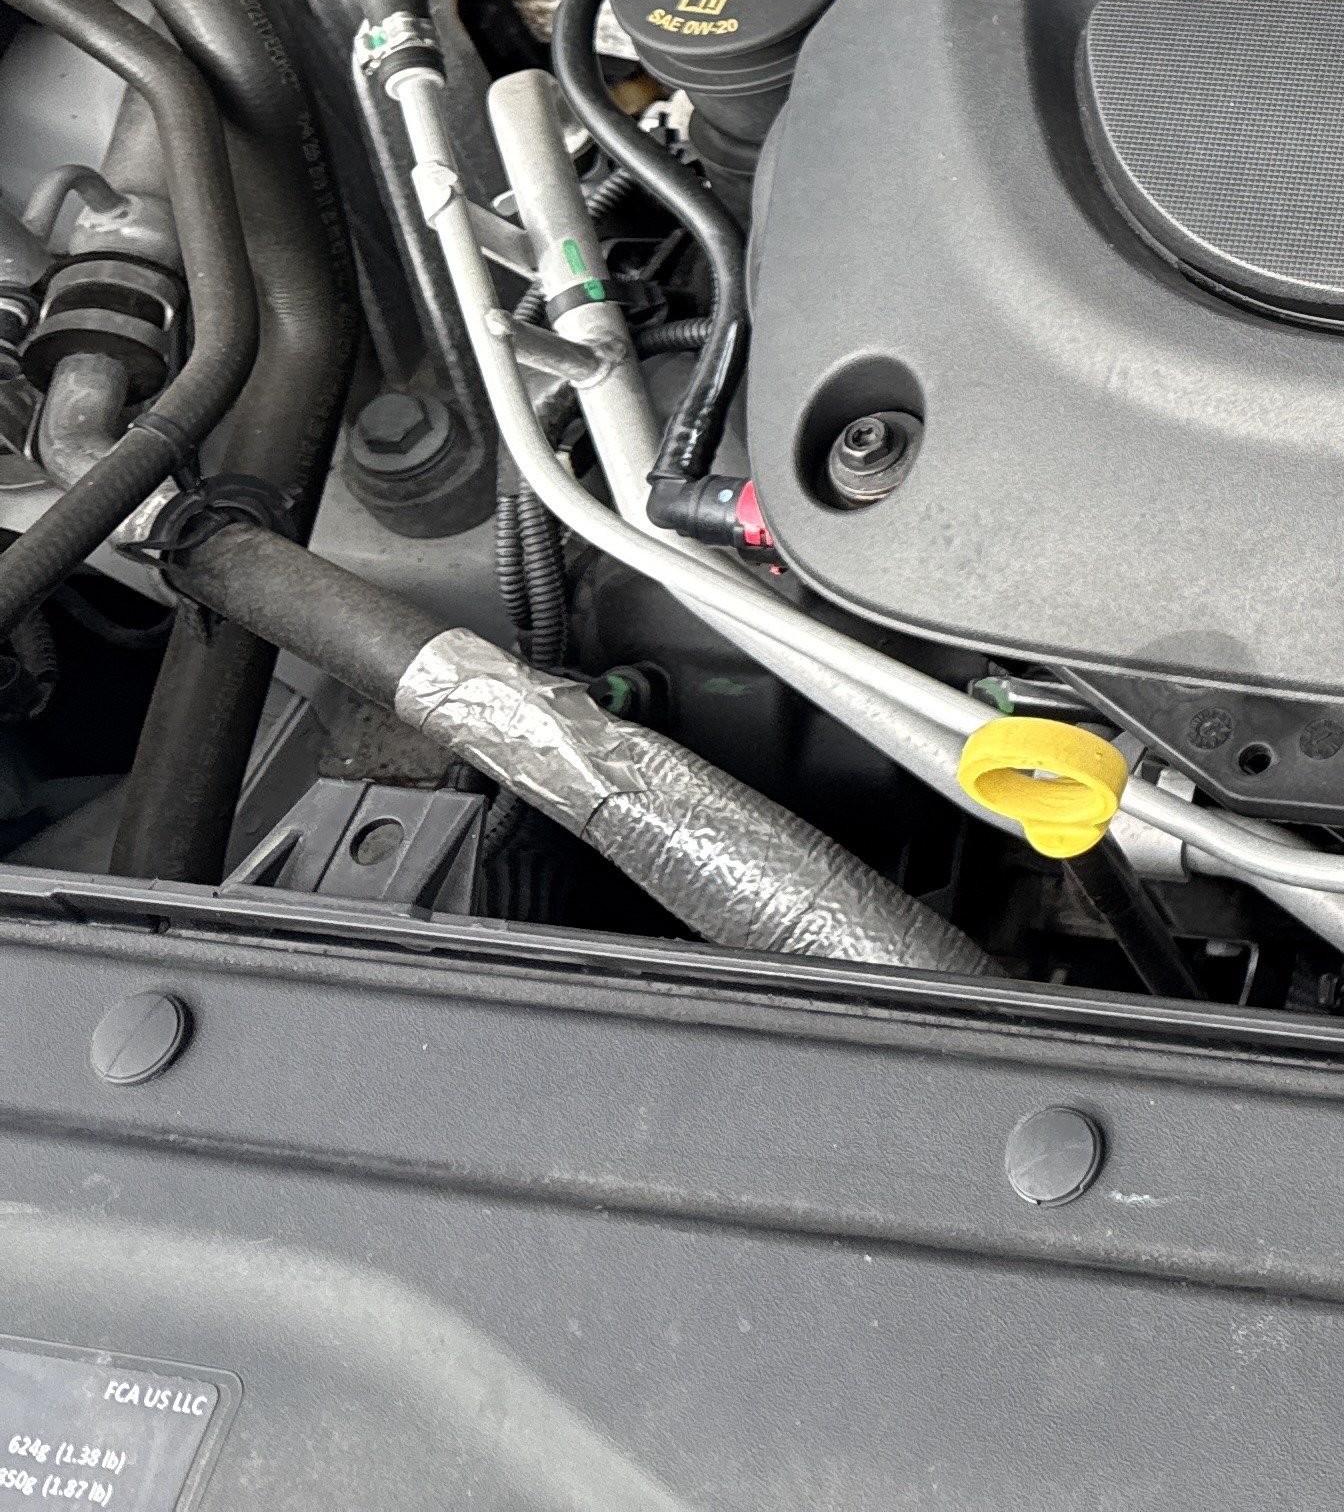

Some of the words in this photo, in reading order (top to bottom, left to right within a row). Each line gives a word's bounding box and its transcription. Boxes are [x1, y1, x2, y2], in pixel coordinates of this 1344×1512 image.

[647, 8, 686, 32] SAE
[684, 18, 739, 35] 0W-20
[103, 1381, 141, 1405] FCA
[143, 1388, 172, 1410] US
[172, 1391, 208, 1416] LLC
[8, 1435, 50, 1464] 624g
[55, 1442, 101, 1467] (1.38
[101, 1449, 126, 1475] lb)
[41, 1474, 89, 1499] (1.87
[88, 1481, 113, 1507] lb)
